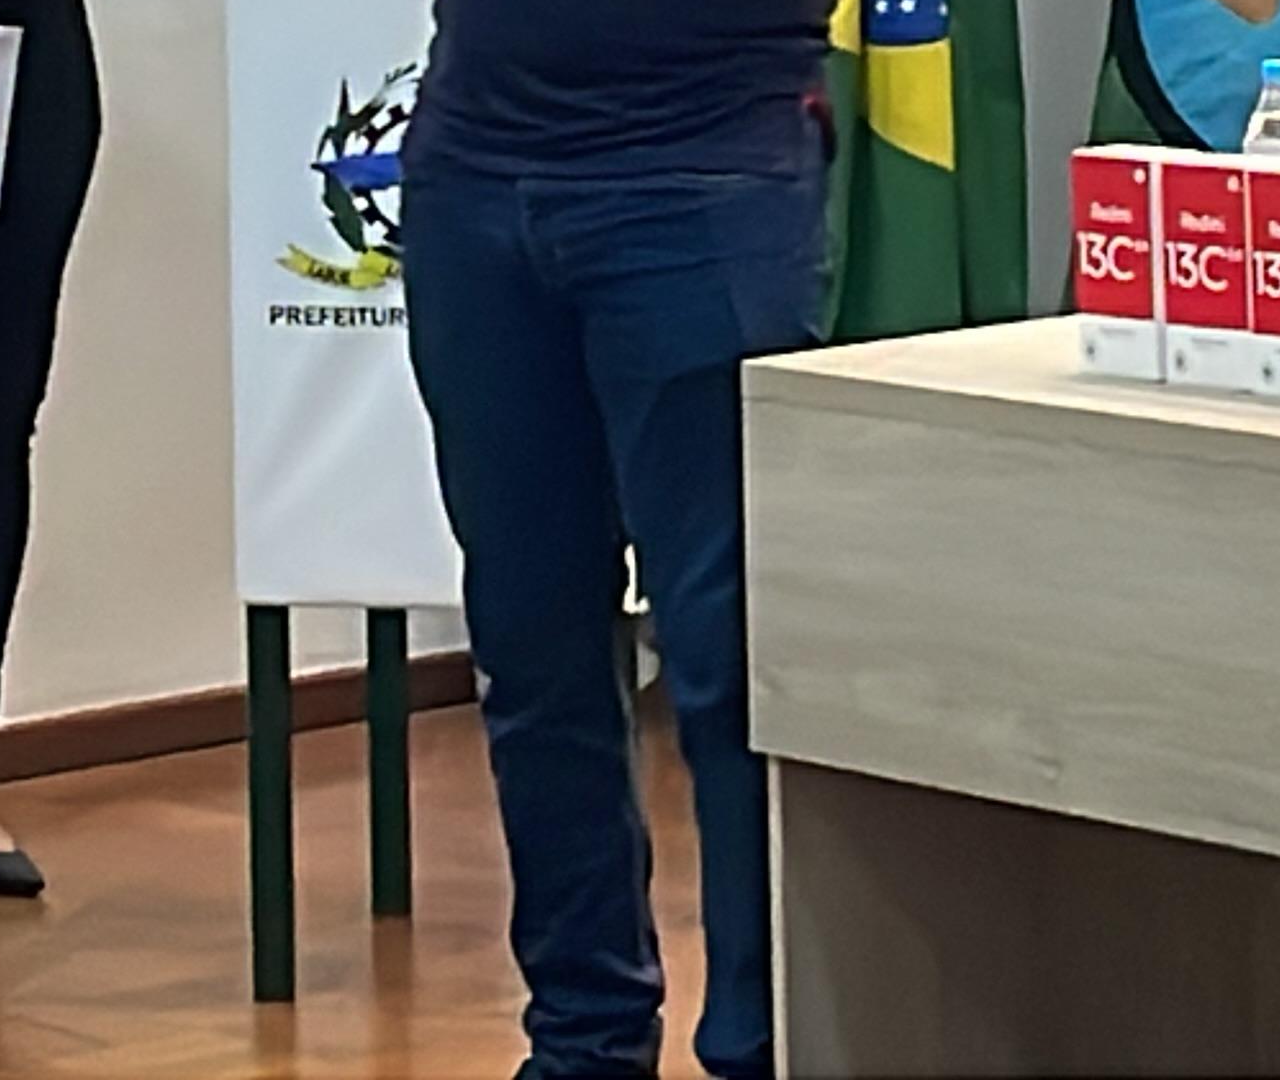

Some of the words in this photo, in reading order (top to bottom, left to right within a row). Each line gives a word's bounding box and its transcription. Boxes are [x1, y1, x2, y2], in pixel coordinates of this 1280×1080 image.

[1076, 232, 1135, 281] 13C
[1166, 242, 1229, 292] 13C
[269, 304, 408, 326] PREFEITUR
